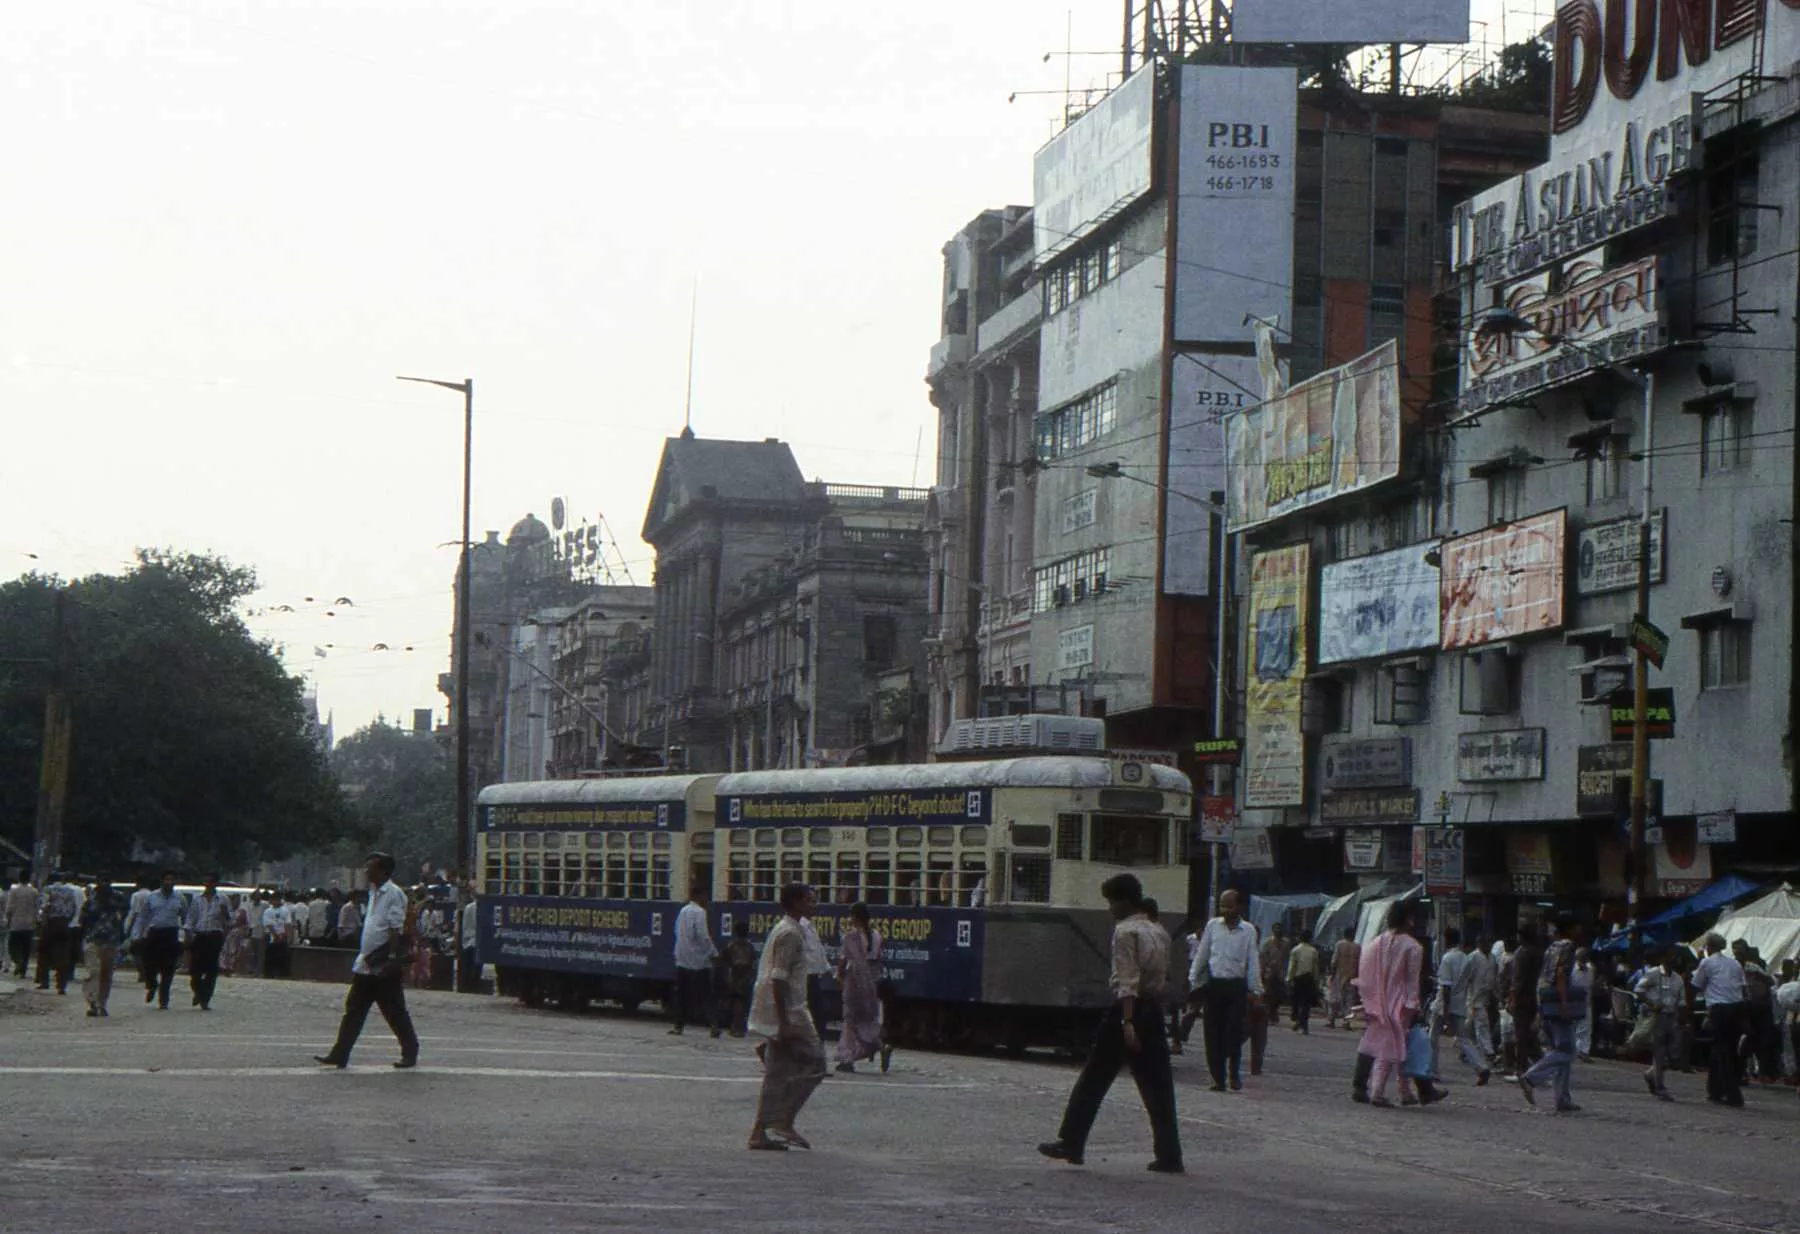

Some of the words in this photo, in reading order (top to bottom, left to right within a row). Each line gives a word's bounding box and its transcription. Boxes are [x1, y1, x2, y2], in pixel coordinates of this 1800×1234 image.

[1553, 0, 1800, 135] DUN
[1208, 122, 1269, 149] P.B.I
[1207, 175, 1274, 191] 466-1718
[1452, 199, 1506, 270] THE
[1509, 151, 1614, 246] ASIAN
[1615, 113, 1693, 201] AGE
[1197, 390, 1244, 407] P.B.I
[1195, 740, 1238, 752] RUPA
[891, 918, 932, 941] GROUP
